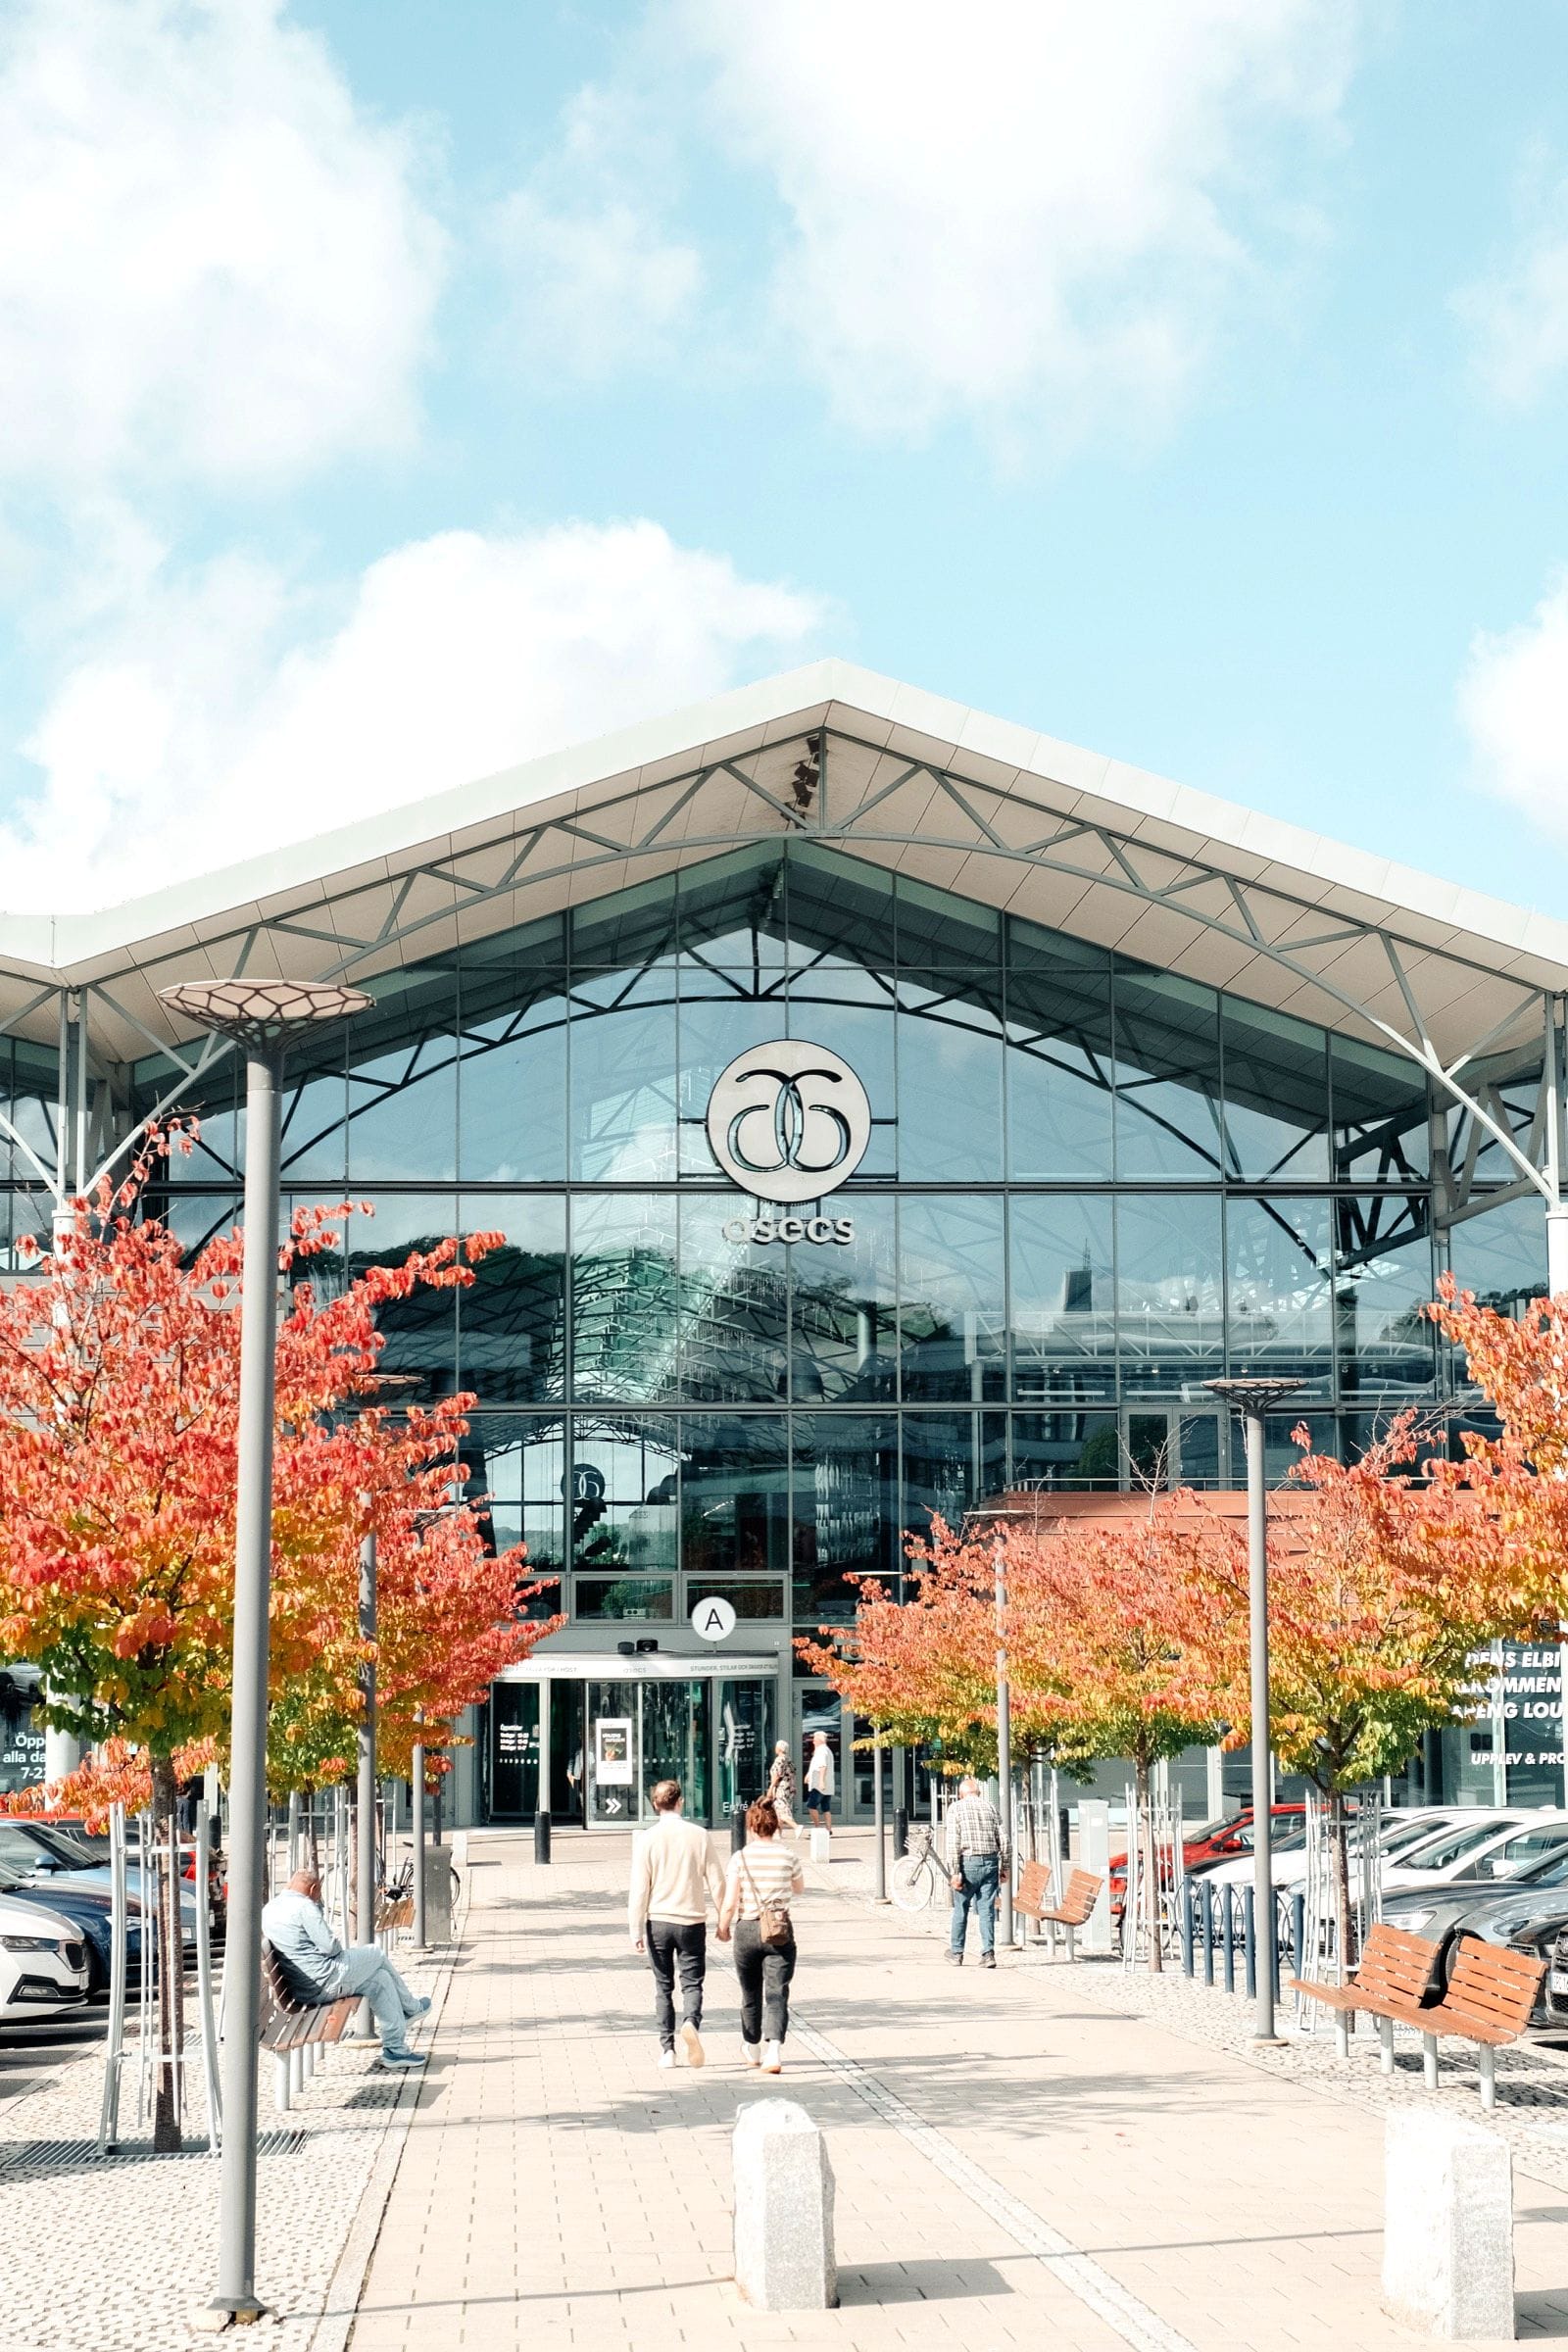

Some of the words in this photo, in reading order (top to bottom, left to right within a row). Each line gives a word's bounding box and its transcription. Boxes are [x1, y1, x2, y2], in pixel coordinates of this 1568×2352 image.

[724, 1216, 856, 1244] asecs
[705, 1608, 724, 1632] A
[2, 1750, 26, 1763] alla
[1471, 1752, 1523, 1765] UPPLEV
[1525, 1752, 1536, 1765] &
[21, 1766, 46, 1780] 7-2
